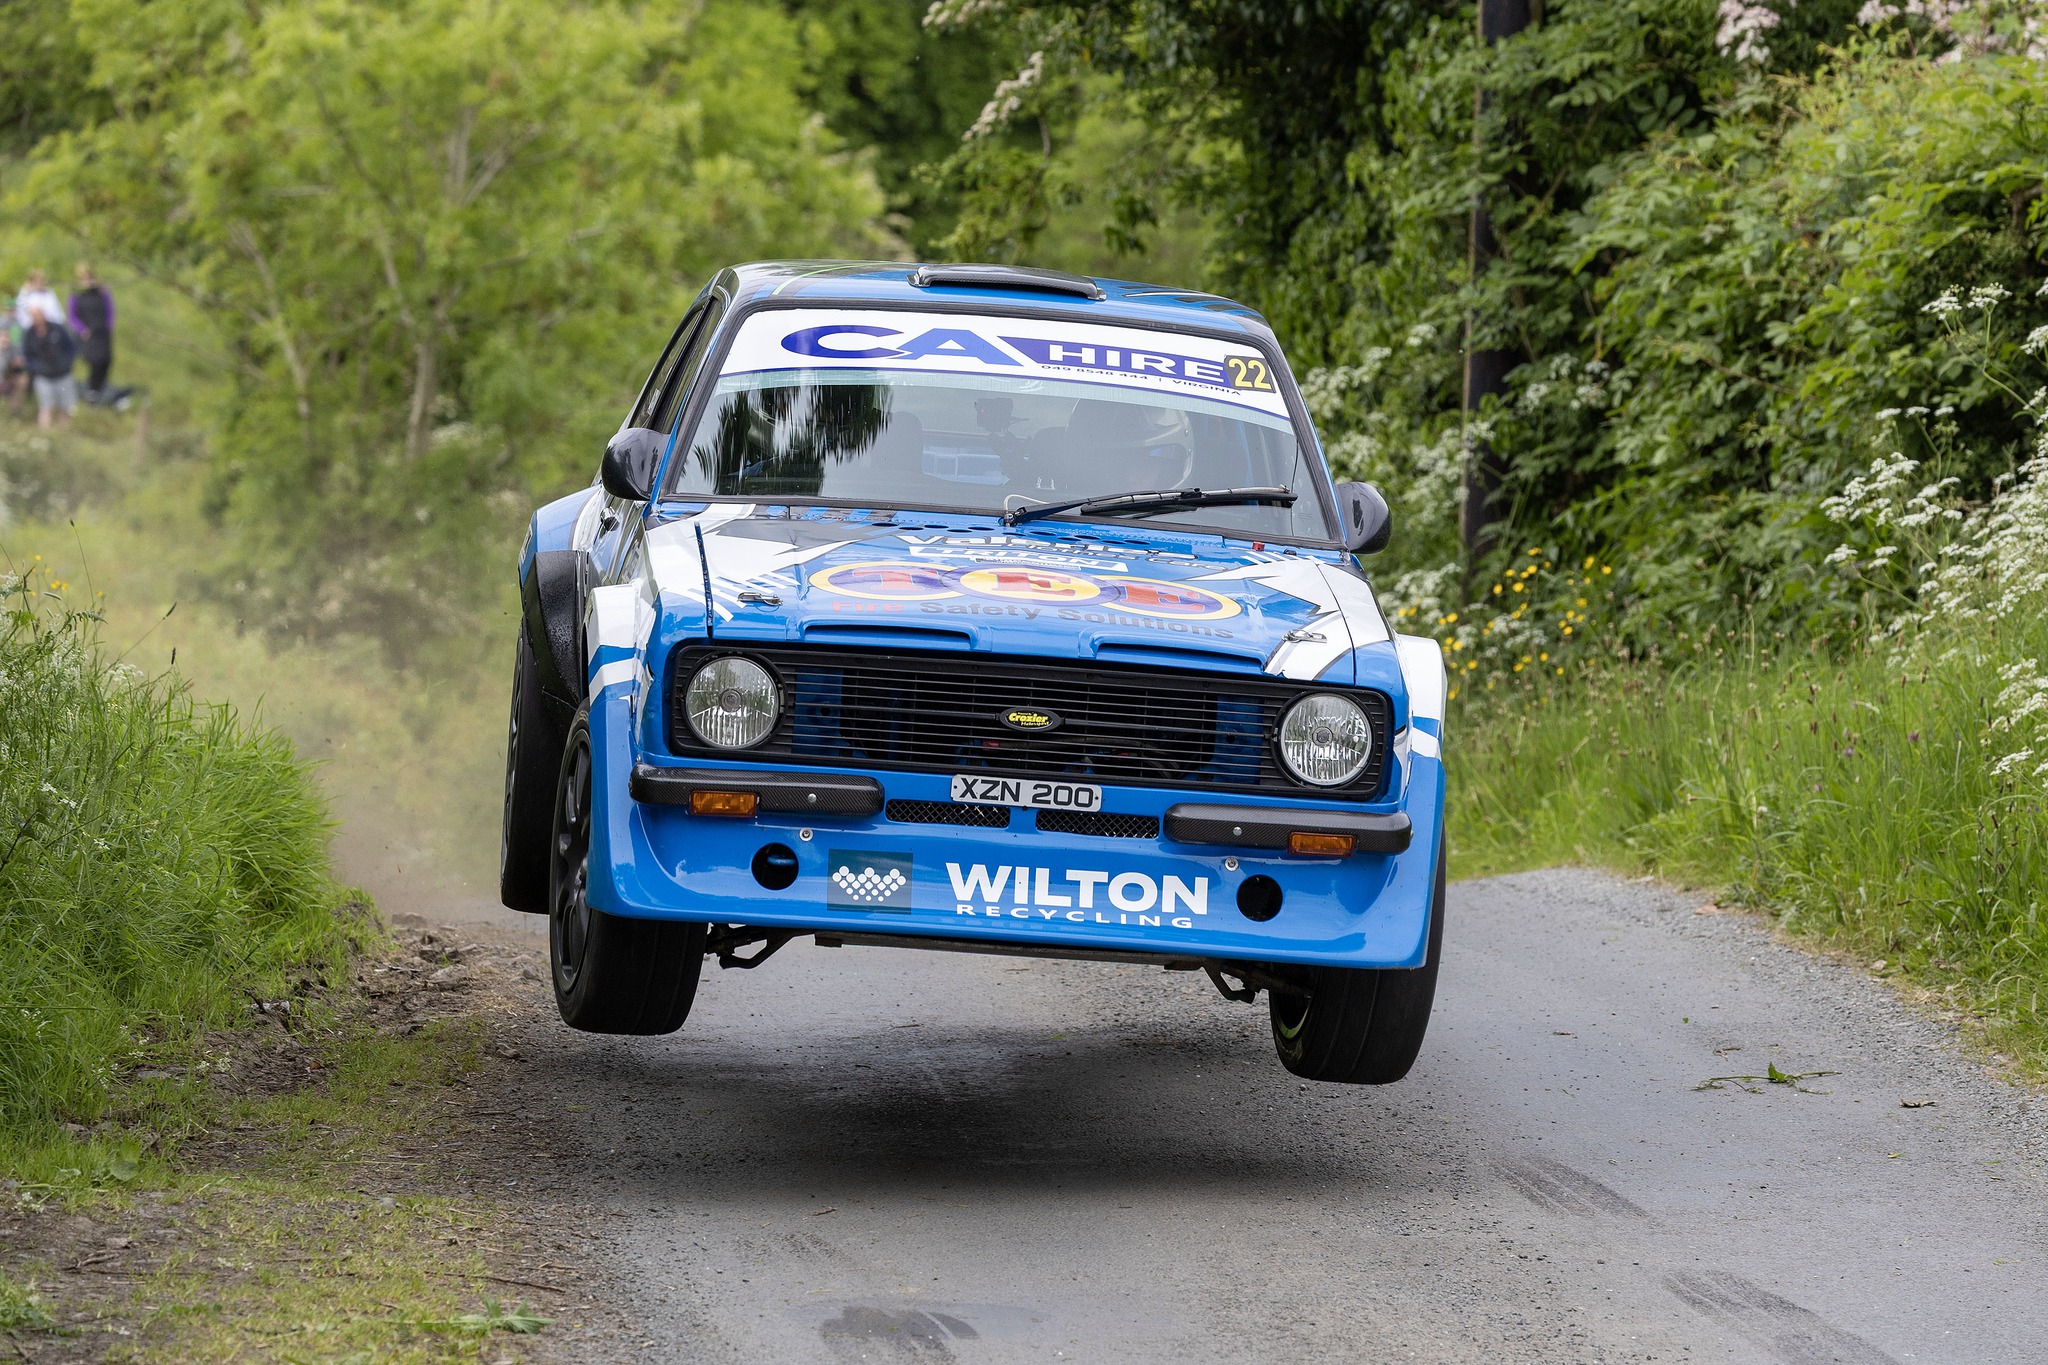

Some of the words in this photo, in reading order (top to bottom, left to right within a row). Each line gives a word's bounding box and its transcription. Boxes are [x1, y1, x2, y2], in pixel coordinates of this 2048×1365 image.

[1049, 344, 1223, 383] HIRE
[1228, 358, 1272, 389] 22
[1173, 379, 1241, 396] VIRGINIA
[936, 548, 1100, 566] TRITON
[832, 601, 904, 613] Fire
[919, 602, 1042, 620] Safety
[1057, 608, 1235, 639] Solutions
[1008, 712, 1048, 723] Crozier
[959, 777, 1021, 802] XZN
[1032, 783, 1094, 808] 200
[946, 862, 1209, 915] WILTON
[956, 904, 1193, 929] RECYCLING
